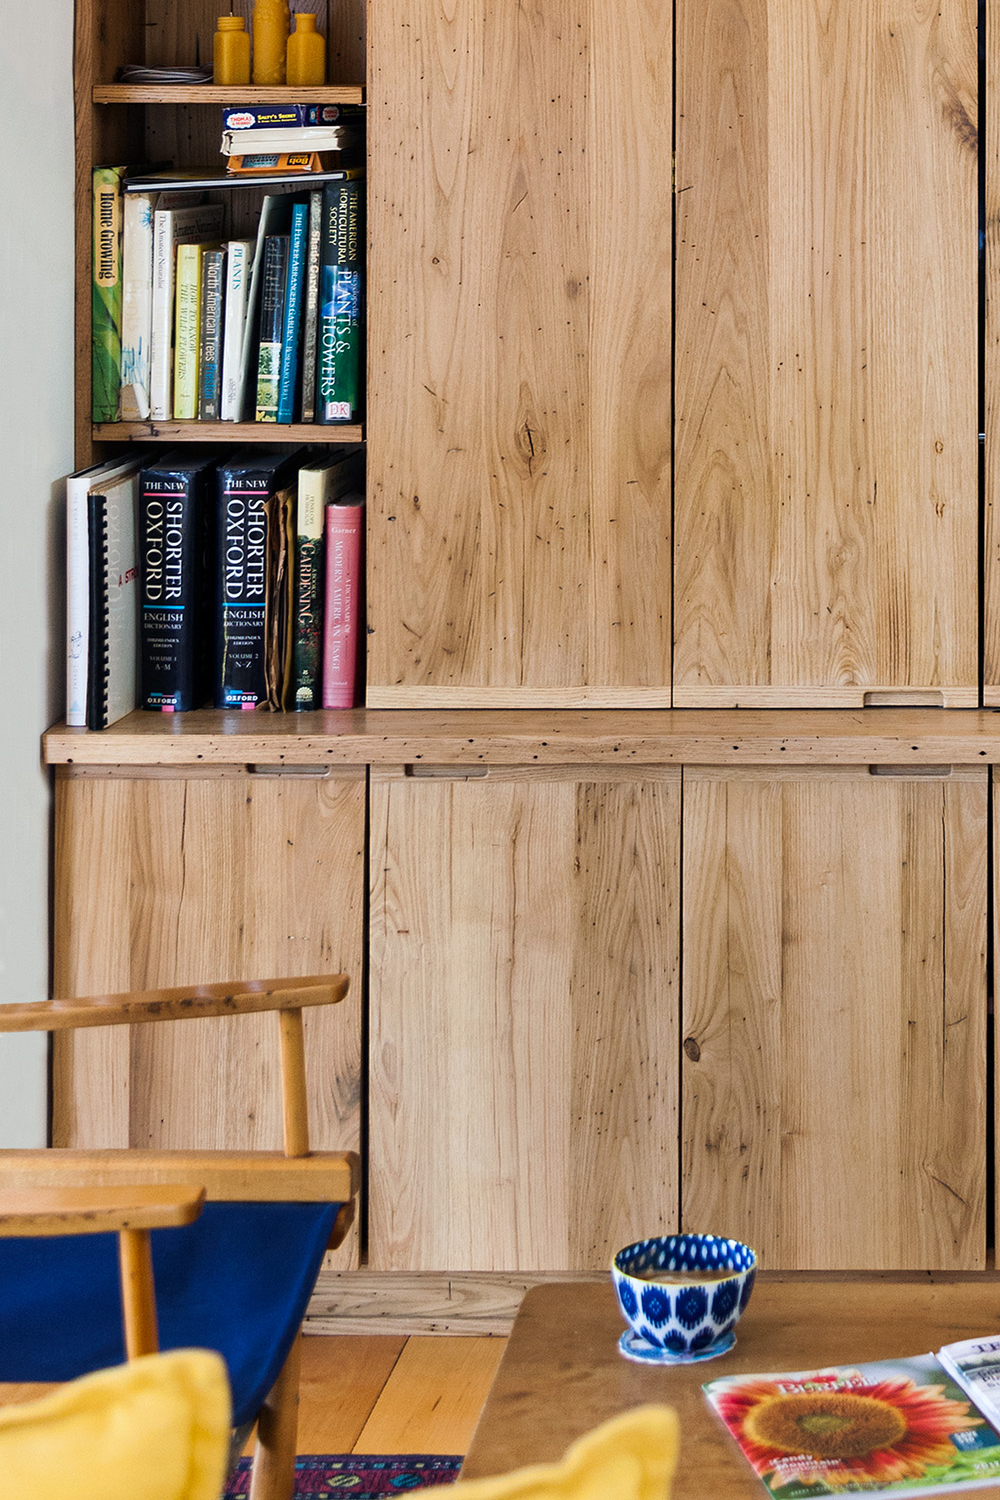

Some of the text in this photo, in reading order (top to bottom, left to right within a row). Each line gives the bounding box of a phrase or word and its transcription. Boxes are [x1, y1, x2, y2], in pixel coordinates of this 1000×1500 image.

[98, 192, 116, 280] Home Growing
[157, 215, 167, 290] The Amateur Naturalist
[292, 228, 302, 260] FLOWER
[295, 212, 303, 228] THE
[328, 207, 338, 246] SOCIETY
[337, 188, 349, 264] HORTICULTURAL
[348, 192, 358, 261] THE AMERICAN
[232, 248, 243, 290] PLANTS
[308, 230, 320, 309] Shade Gardens
[350, 270, 360, 327] encyclopedia of
[178, 283, 189, 381] THE WILD FLOWERS
[188, 283, 198, 355] HOW TO KNOW
[204, 262, 221, 400] North American Trees Preston
[286, 308, 296, 342] GARDEN
[336, 270, 352, 353] PLANTS &
[321, 315, 337, 396] FLOWERS
[329, 403, 349, 416] DK
[144, 481, 186, 491] THE NEW
[225, 480, 268, 488] THE NEW
[146, 501, 164, 601] OXFORD
[165, 501, 183, 601] SHORTER
[226, 499, 245, 599] OXFORD
[246, 499, 265, 599] SHORTER
[331, 526, 357, 534] Garner
[144, 612, 184, 622] ENGLISH
[223, 610, 265, 619] ENGLISH
[298, 542, 316, 624] GARDENING
[332, 539, 344, 671] MODERN AMERICAN USAGE
[343, 623, 351, 633] OF
